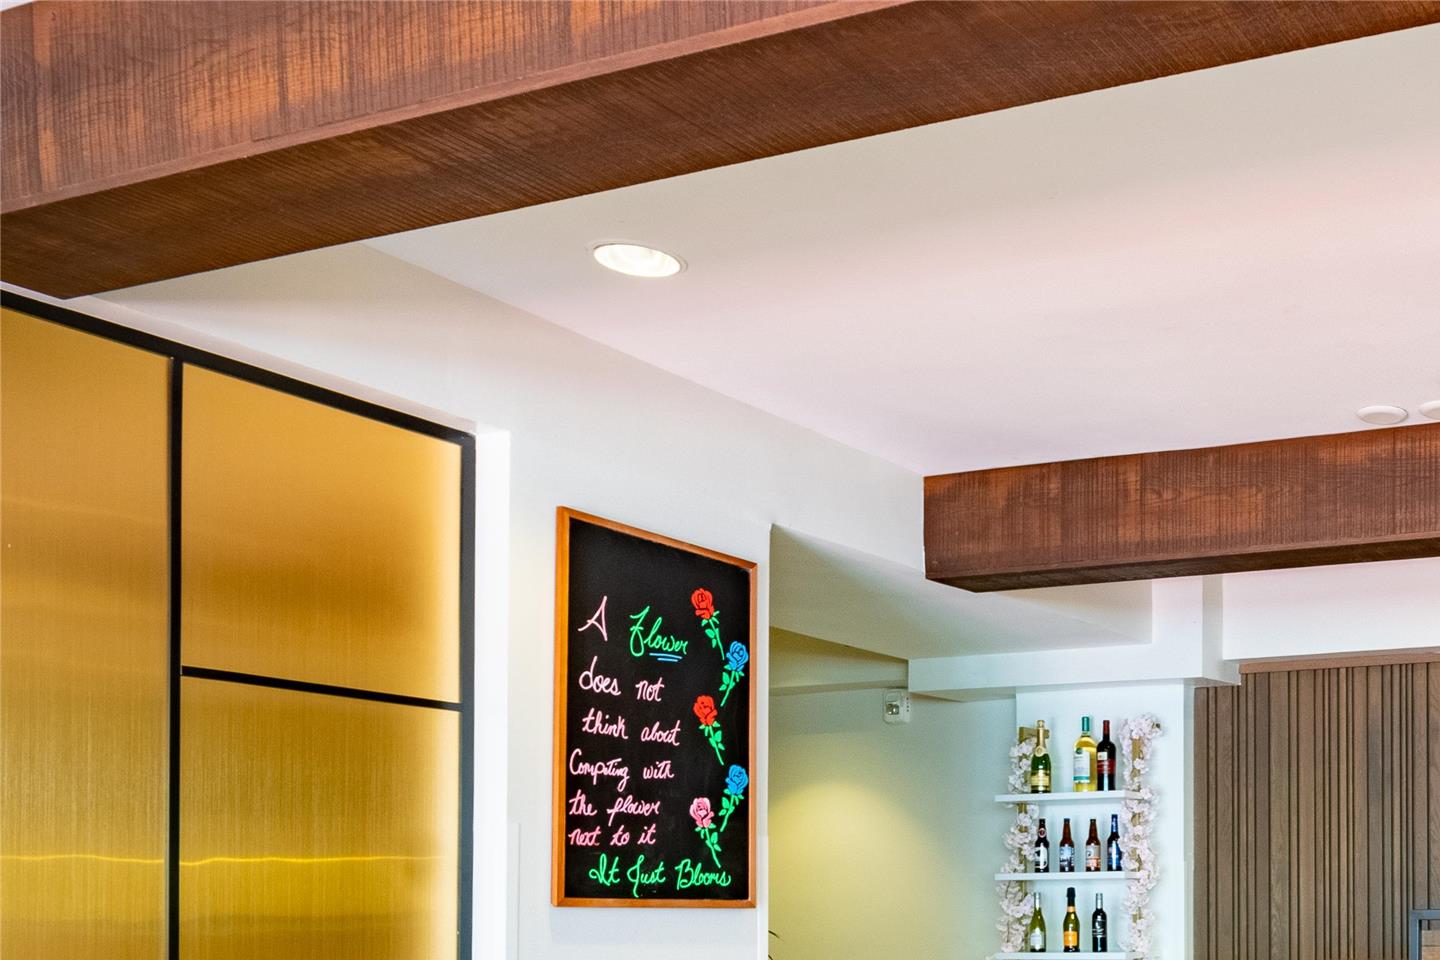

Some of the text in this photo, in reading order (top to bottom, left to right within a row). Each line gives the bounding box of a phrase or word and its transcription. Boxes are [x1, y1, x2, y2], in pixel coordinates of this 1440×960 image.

[578, 595, 689, 657] A Flower
[578, 655, 665, 702] does not
[582, 707, 680, 746] think about
[642, 760, 675, 780] with
[569, 793, 660, 828] the flower
[568, 823, 656, 846] next to it
[589, 854, 620, 887] It
[627, 858, 665, 898] Just
